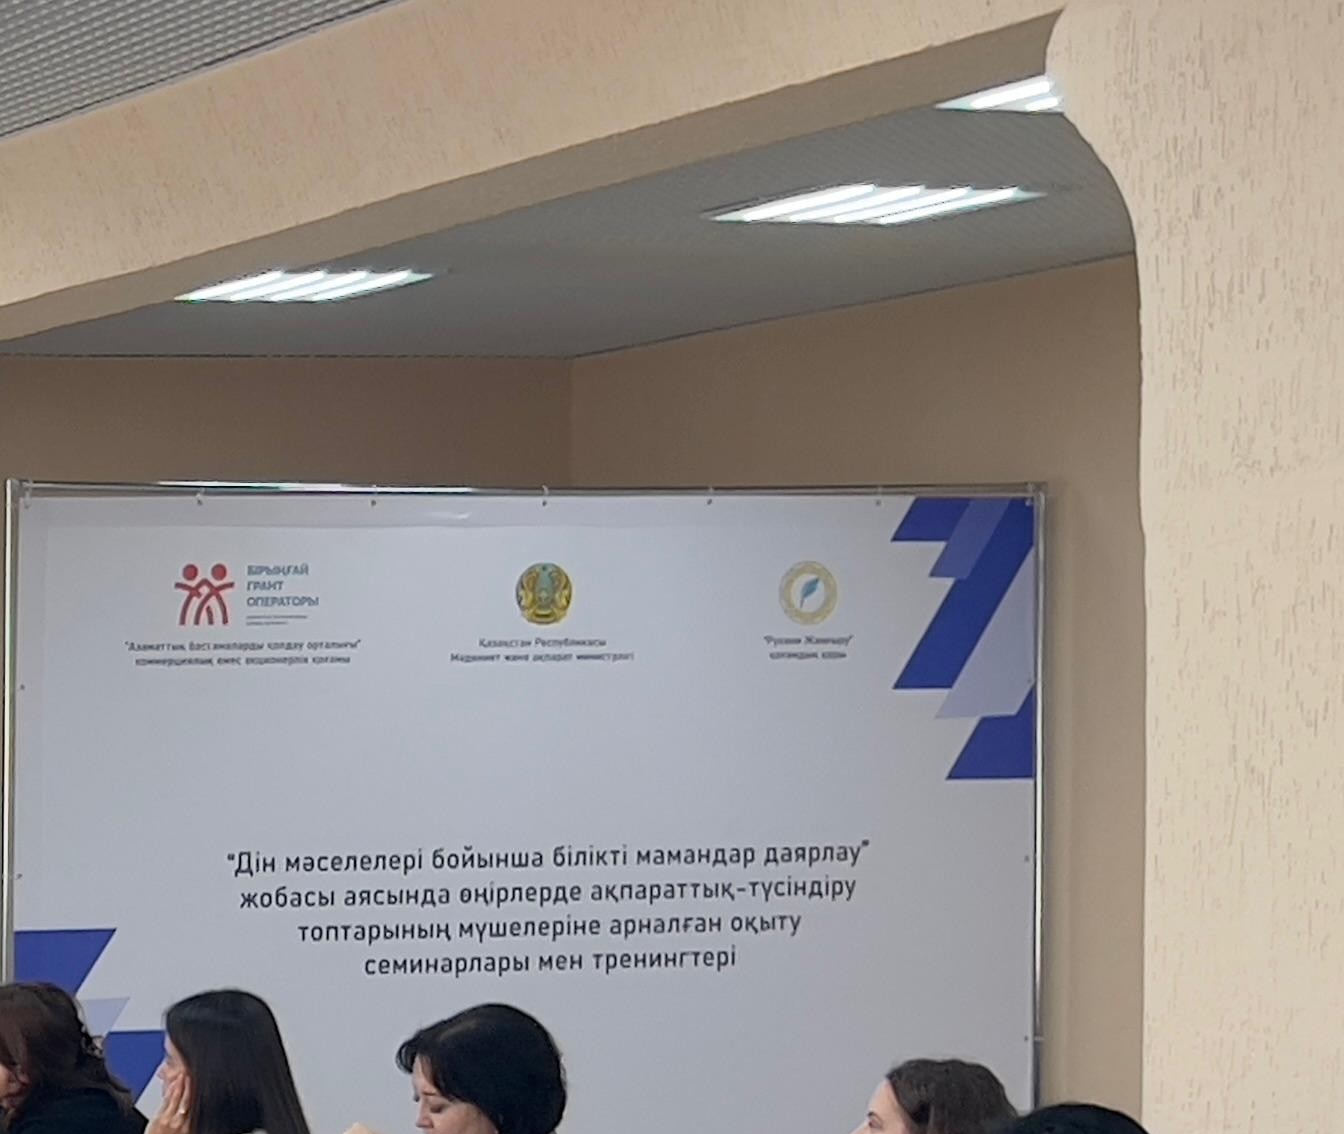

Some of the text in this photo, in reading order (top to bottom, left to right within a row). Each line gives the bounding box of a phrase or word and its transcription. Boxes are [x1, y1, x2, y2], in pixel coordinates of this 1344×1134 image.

[246, 580, 284, 592] ГРАНТ
[246, 595, 320, 608] ОПЕРАТОРЫ
[227, 839, 870, 878] "Дін мәселелері бойынша білікті мамандар даярлау"
[239, 874, 857, 909] жобасы аясында өңірлерде ақпараттық-түсіндіру
[297, 913, 802, 946] топтарының мүшелеріне арналған оқыту
[364, 944, 736, 979] семинарлары мен тренингтері
